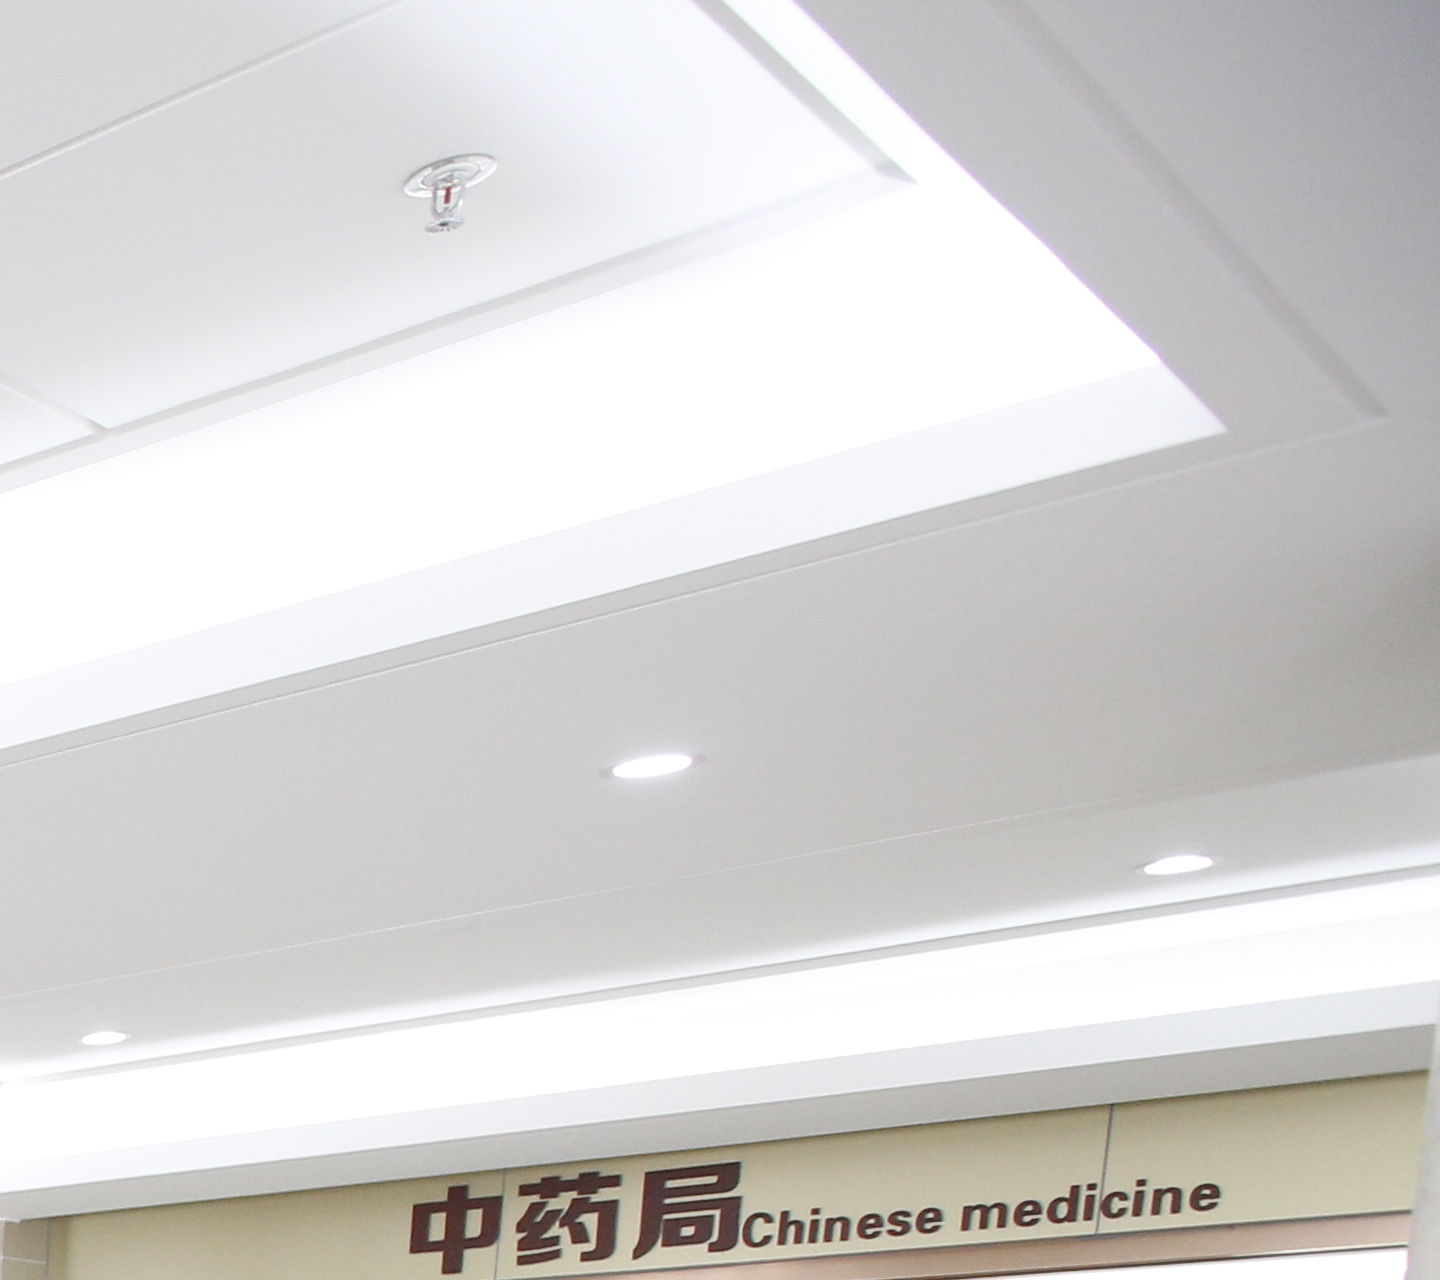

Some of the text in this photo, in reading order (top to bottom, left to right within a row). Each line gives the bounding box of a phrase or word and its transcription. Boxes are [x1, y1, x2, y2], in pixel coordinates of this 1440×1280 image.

[409, 1161, 1221, 1275] 中药局 Chinese medicine
